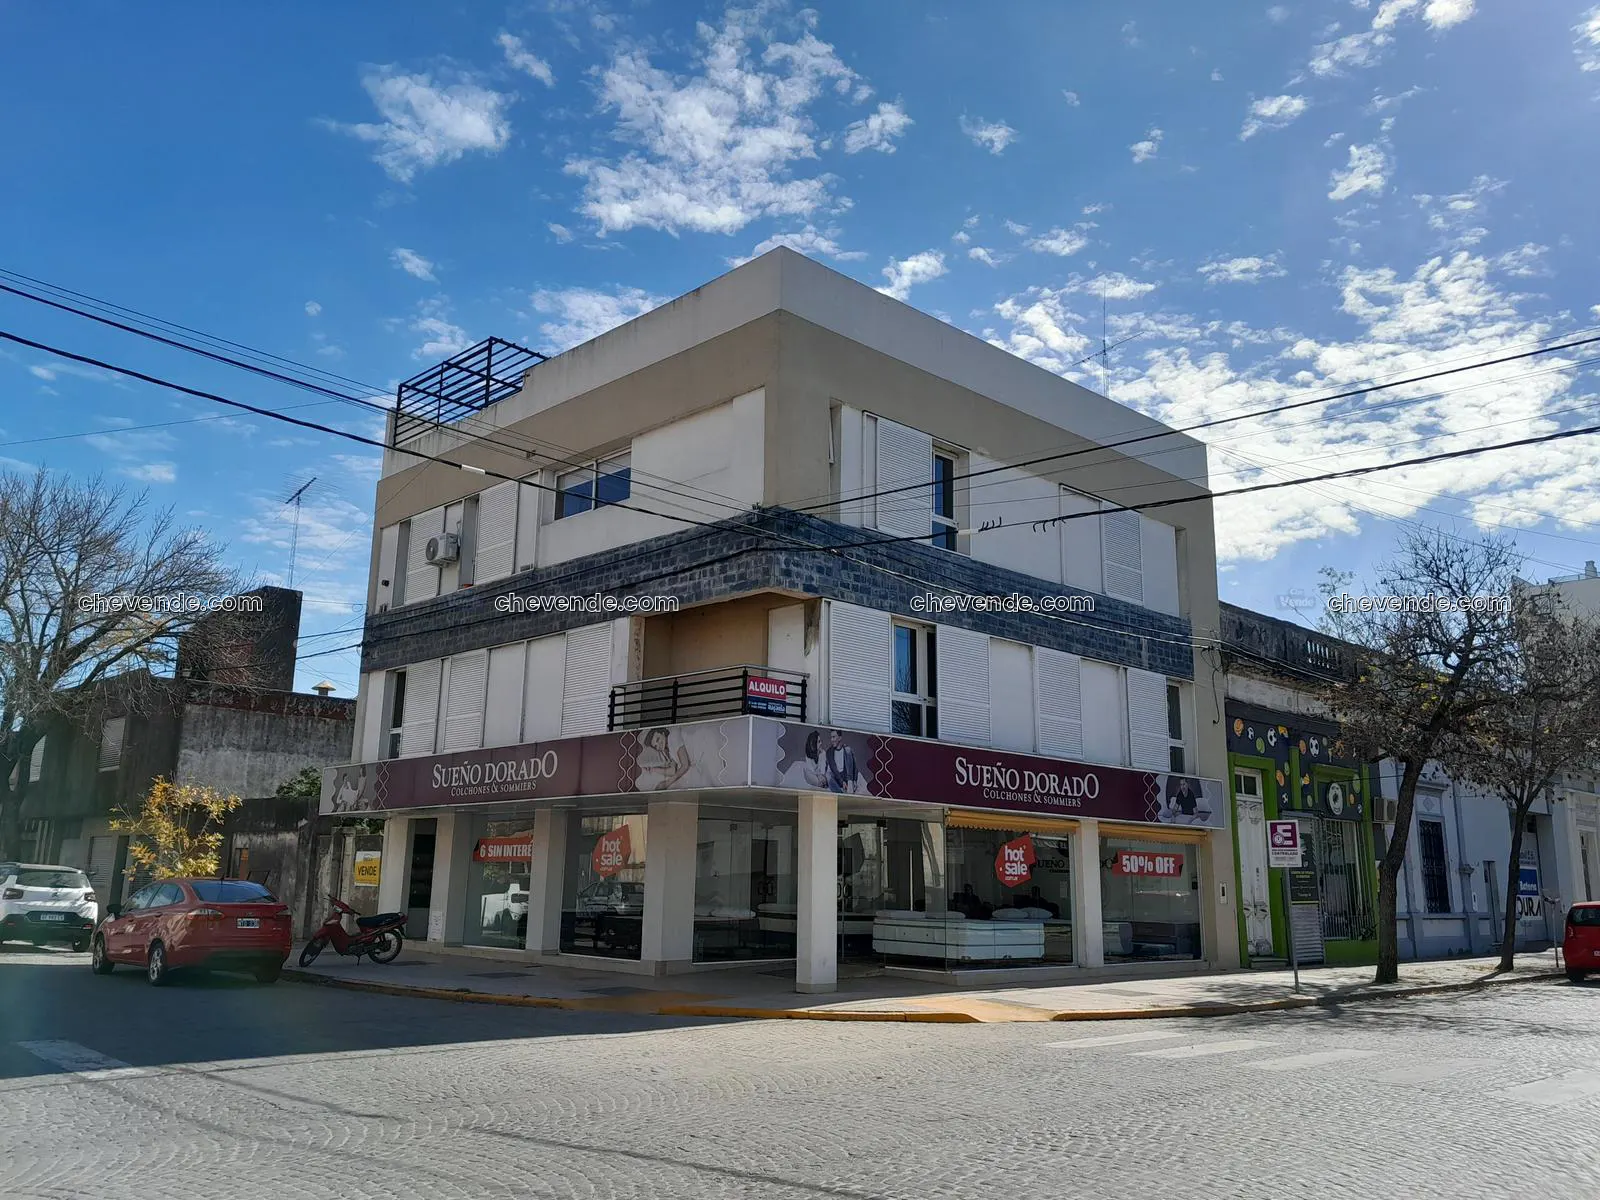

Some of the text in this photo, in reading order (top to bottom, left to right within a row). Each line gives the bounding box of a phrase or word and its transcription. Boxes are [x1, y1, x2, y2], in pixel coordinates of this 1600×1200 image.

[748, 681, 785, 695] ALQUILO
[432, 750, 558, 789] SUEÑO DORADO
[955, 756, 1099, 799] SUEÑO DORADO
[450, 779, 537, 797] COLCHONES & SOMMIERS
[983, 788, 1081, 808] COLCHONES & SOMMIERS
[480, 844, 486, 858] 6
[487, 844, 503, 858] SIN
[602, 837, 621, 853] hot
[1005, 845, 1025, 861] hot
[600, 852, 623, 867] sale
[1122, 855, 1153, 874] 50%
[1155, 857, 1175, 874] OFF
[357, 865, 377, 876] VENDE
[1005, 860, 1028, 876] sale
